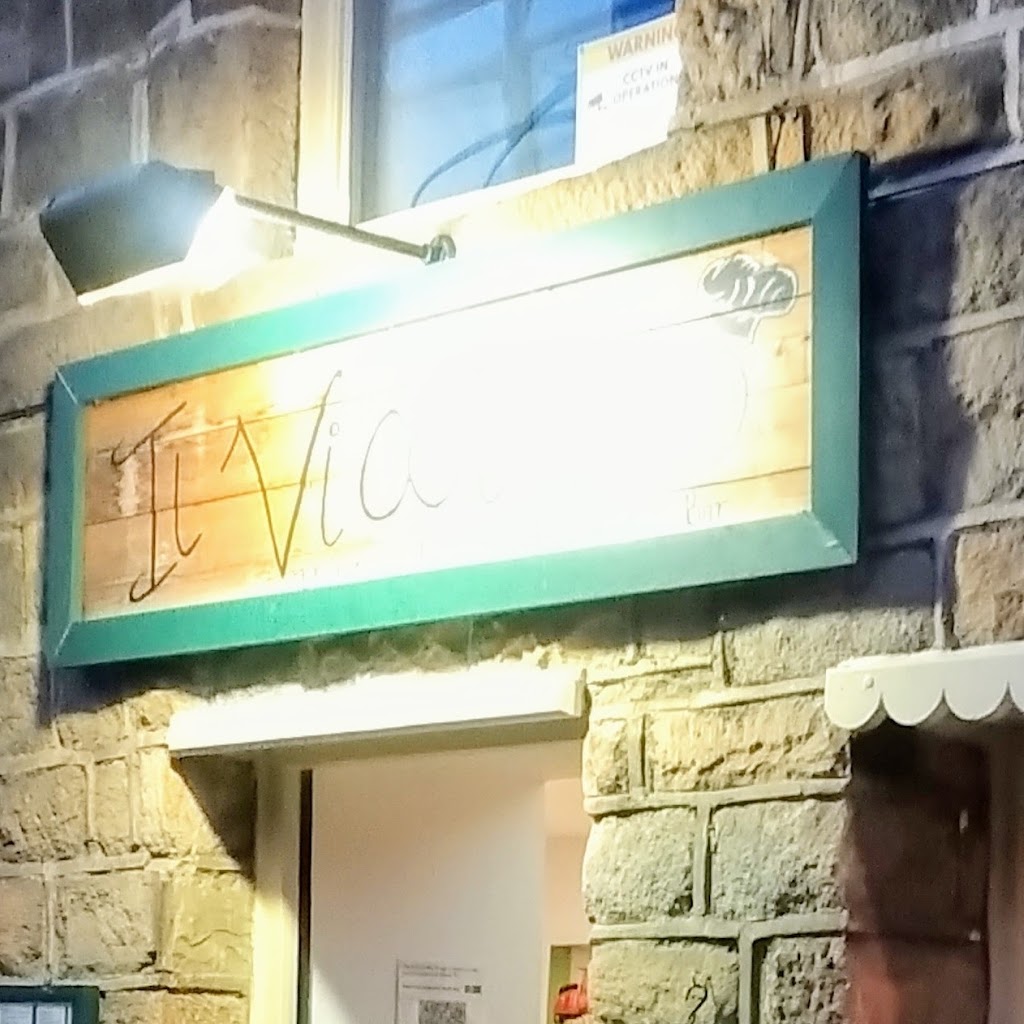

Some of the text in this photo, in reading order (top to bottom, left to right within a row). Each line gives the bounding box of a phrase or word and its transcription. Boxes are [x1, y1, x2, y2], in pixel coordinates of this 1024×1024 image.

[607, 25, 673, 61] WARNIN
[623, 60, 668, 85] CCTV IN
